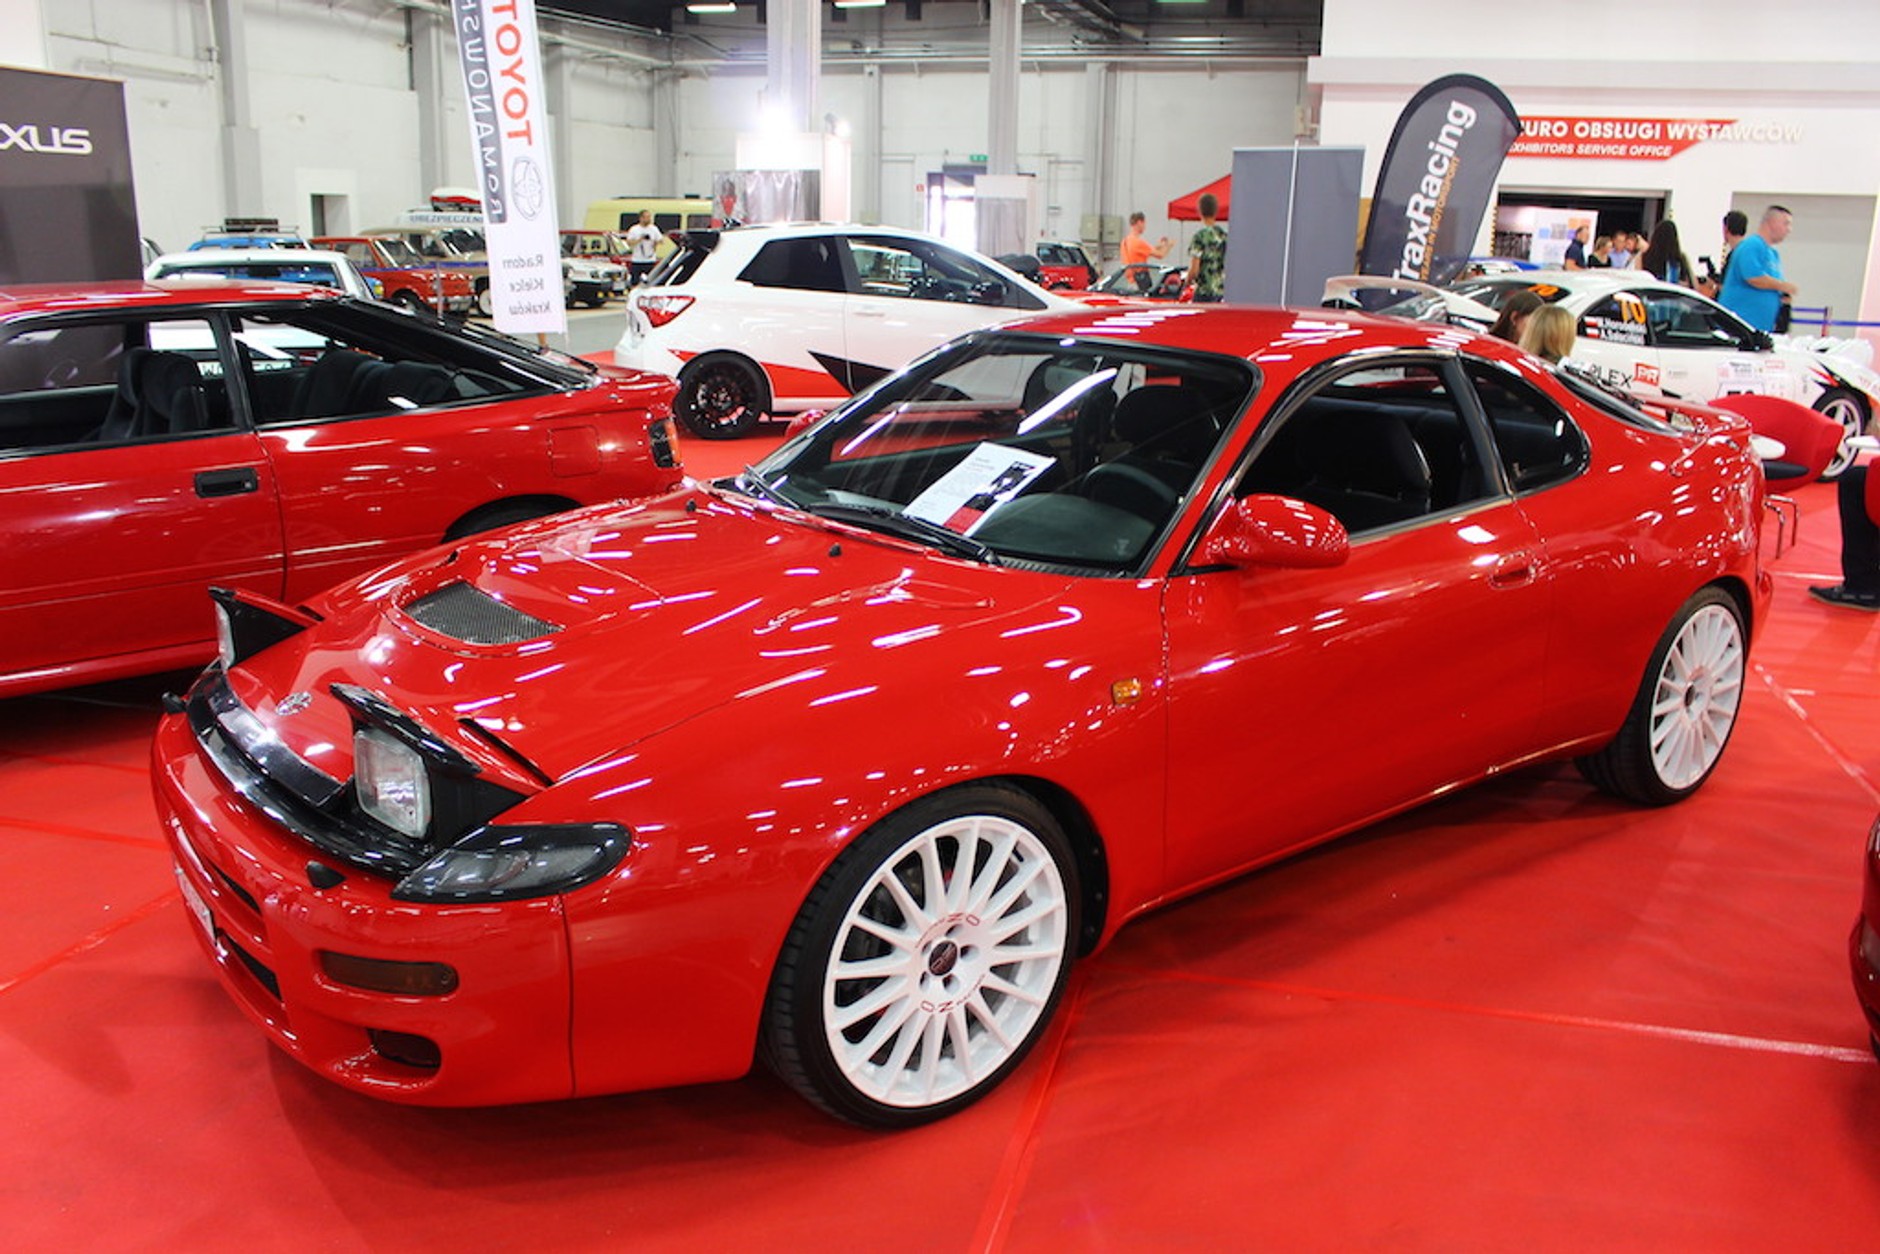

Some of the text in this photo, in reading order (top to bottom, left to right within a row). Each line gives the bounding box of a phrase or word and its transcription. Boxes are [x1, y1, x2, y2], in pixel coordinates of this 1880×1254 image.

[1574, 121, 1660, 139] OBSŁUGI
[1576, 144, 1627, 155] SERVICE
[1629, 145, 1673, 157] OFFICE
[1612, 291, 1647, 325] 70
